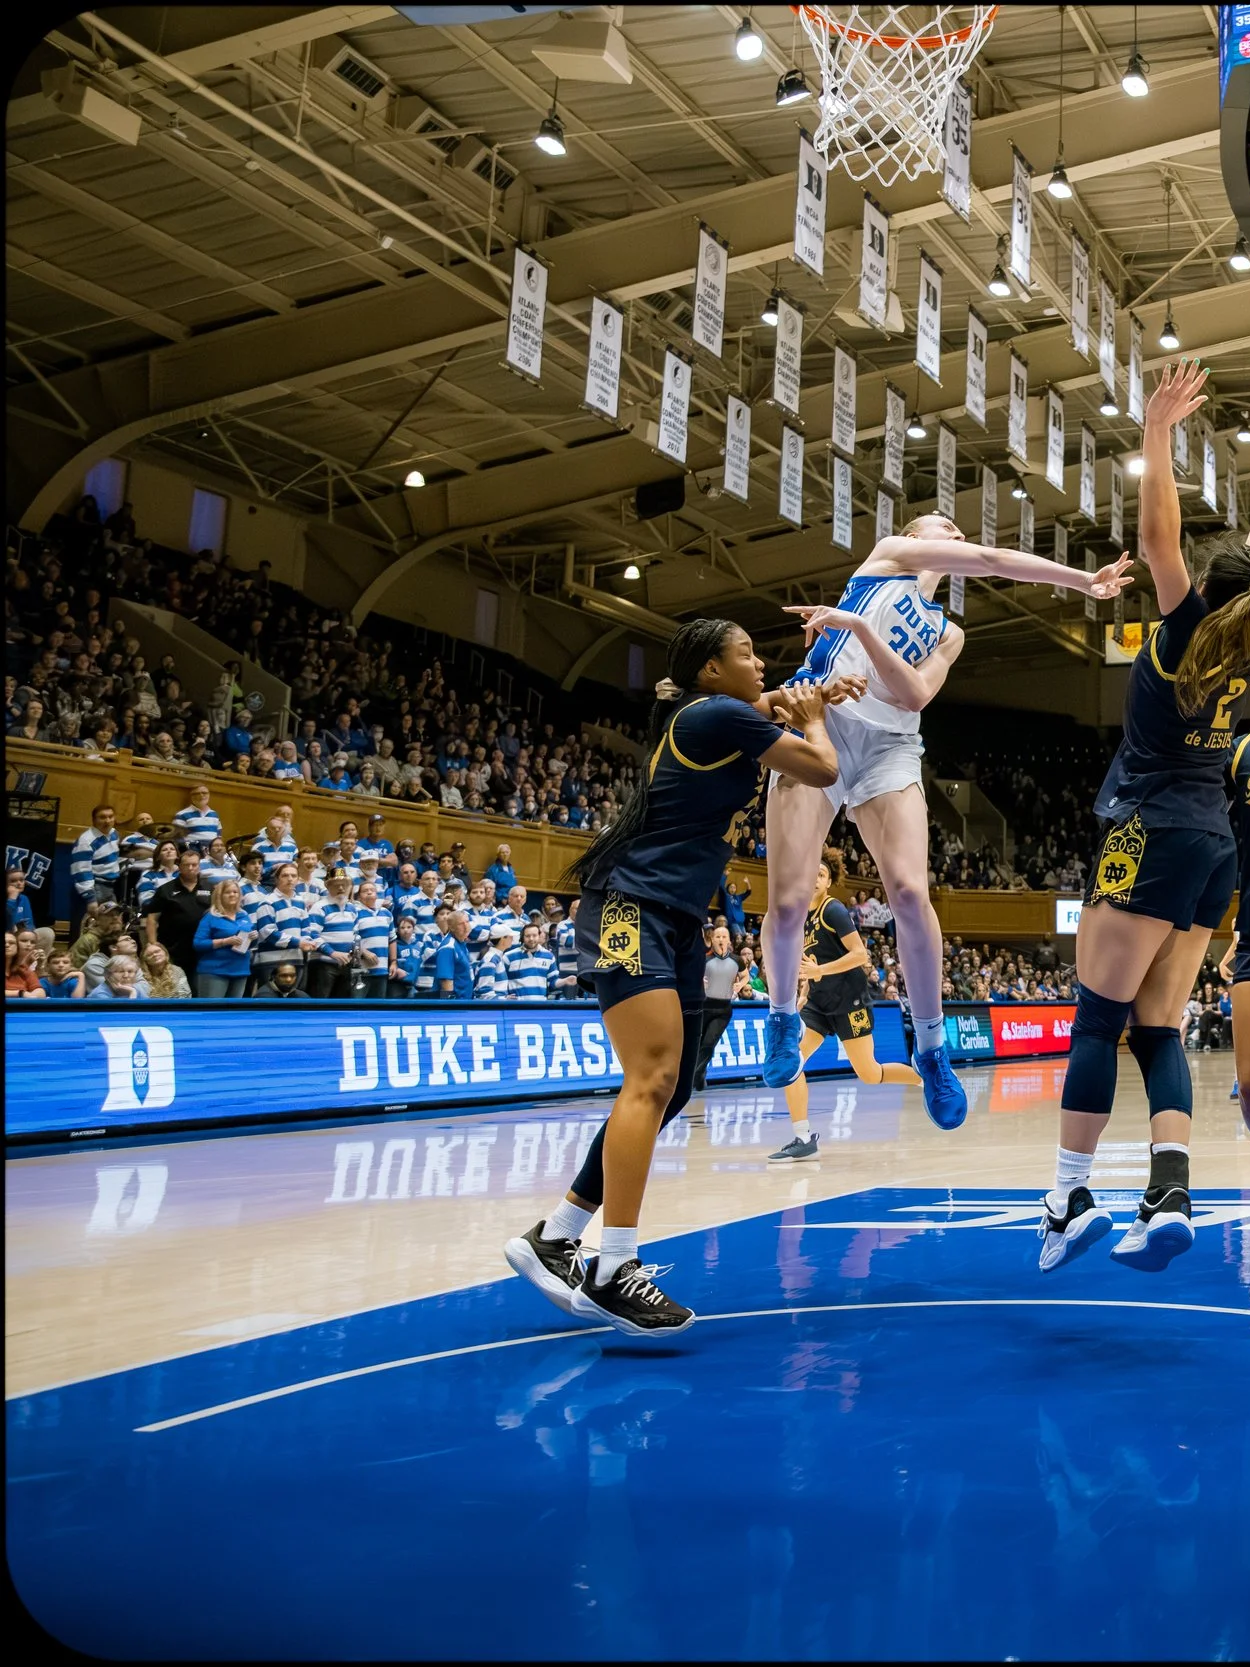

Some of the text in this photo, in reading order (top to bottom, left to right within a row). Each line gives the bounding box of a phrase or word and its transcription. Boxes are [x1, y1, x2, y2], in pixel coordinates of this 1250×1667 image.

[951, 115, 969, 156] 35
[1210, 676, 1248, 729] 2
[1184, 729, 1232, 749] de JESUS
[5, 845, 52, 889] KE
[1067, 911, 1080, 924] FO
[957, 1015, 979, 1032] North
[960, 1032, 990, 1050] Carolina
[98, 1026, 176, 1112] D
[336, 1024, 501, 1092] DUKE
